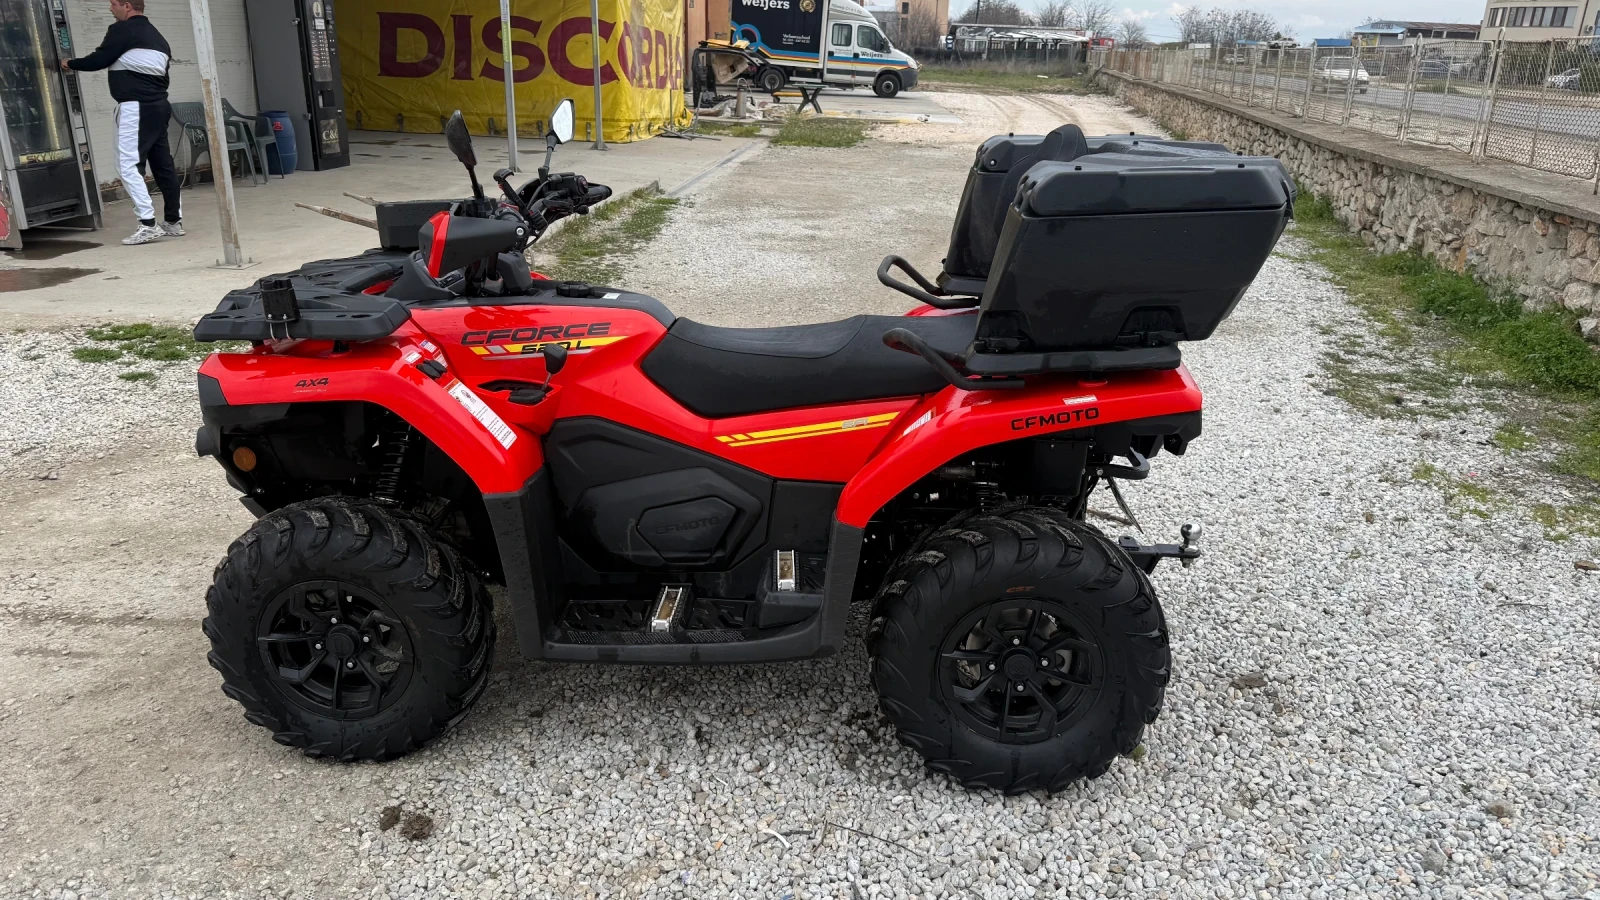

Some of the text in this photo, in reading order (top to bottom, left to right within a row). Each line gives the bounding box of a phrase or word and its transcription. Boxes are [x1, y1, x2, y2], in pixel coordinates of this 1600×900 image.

[376, 11, 683, 90] DISCORDIA
[461, 322, 611, 346] CFORCE
[576, 340, 592, 350] L
[842, 418, 868, 429] EFI
[1011, 407, 1099, 431] CFMOTO
[656, 516, 720, 535] CFMOTO
[1005, 585, 1035, 594] CST
